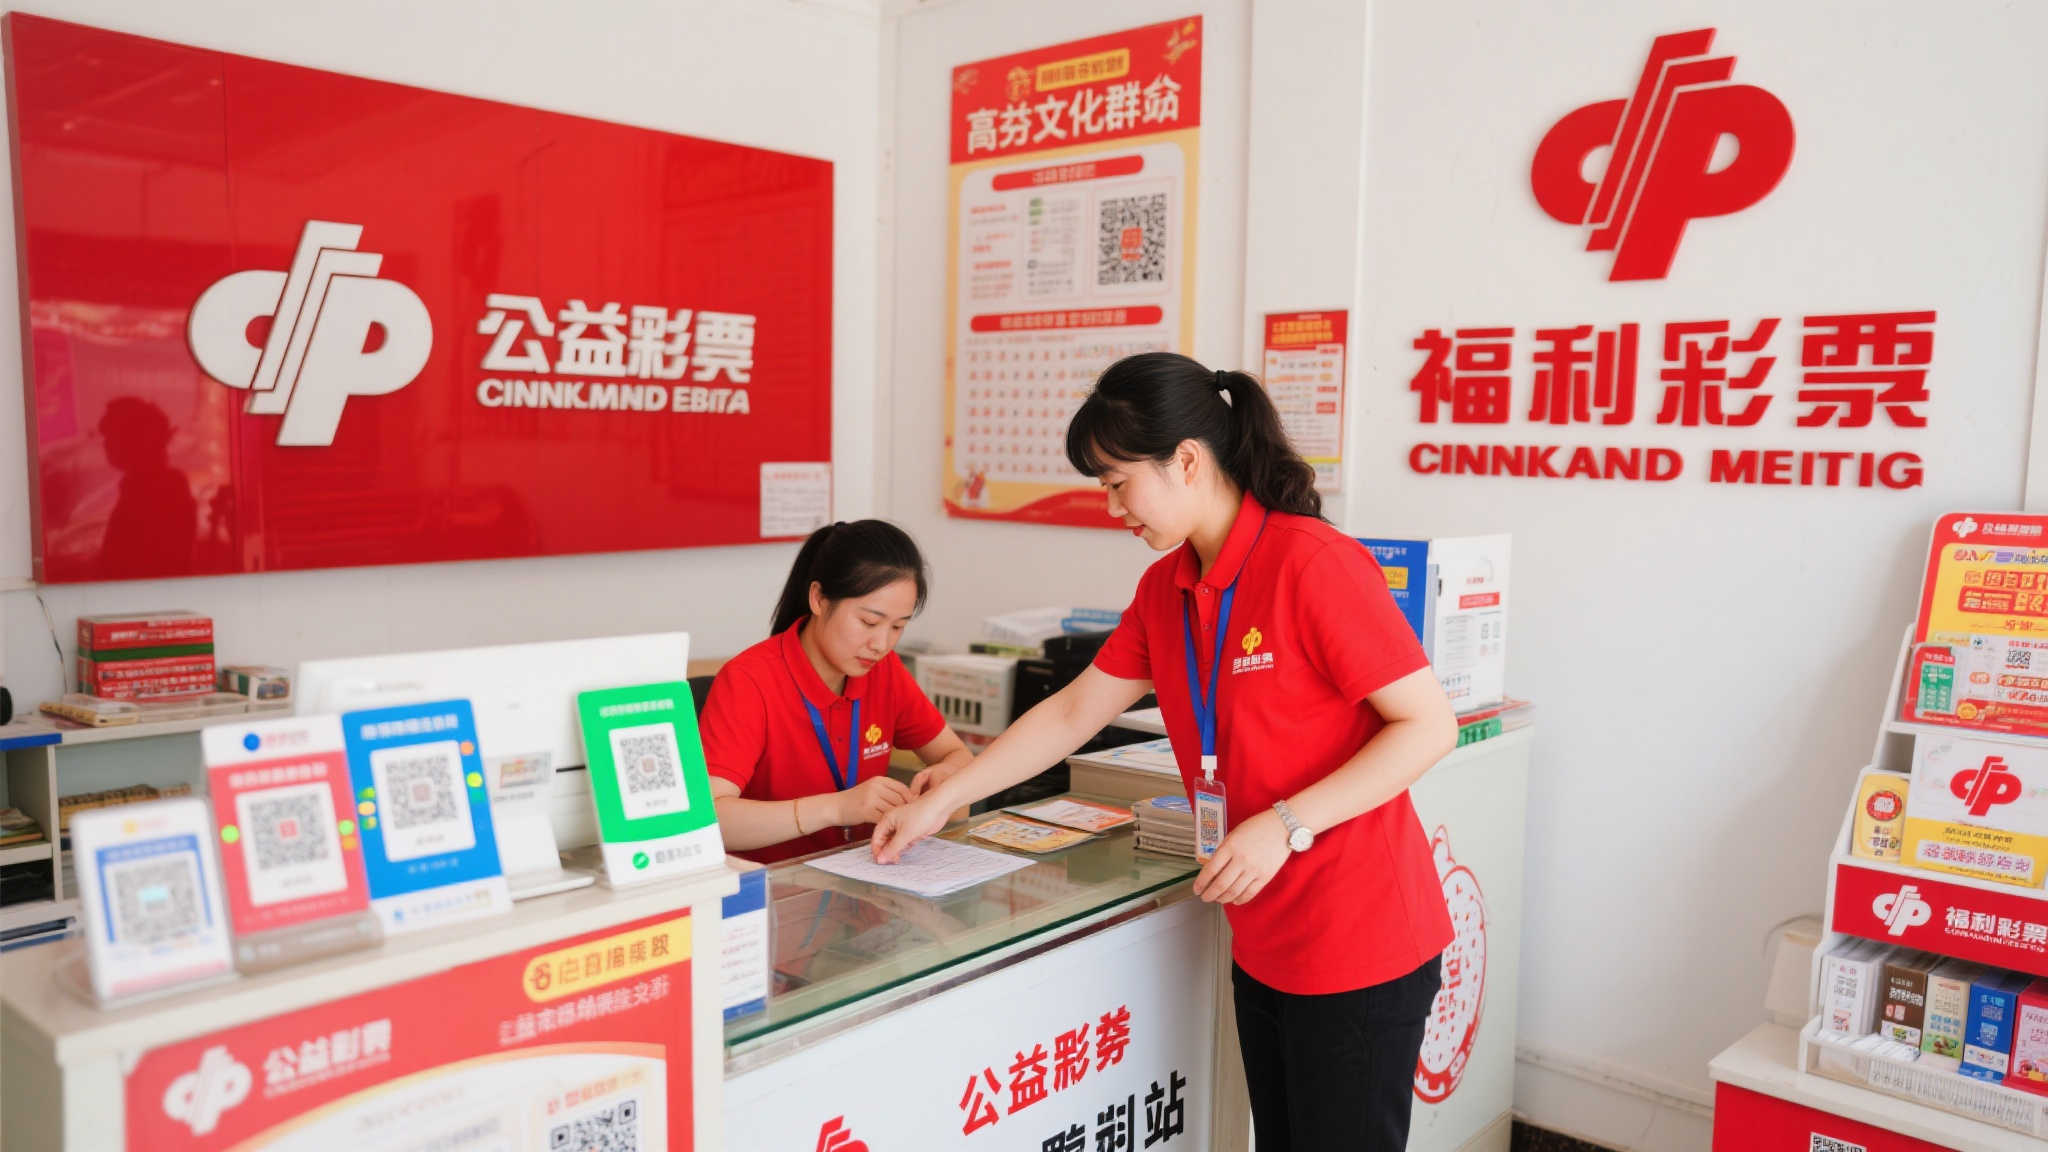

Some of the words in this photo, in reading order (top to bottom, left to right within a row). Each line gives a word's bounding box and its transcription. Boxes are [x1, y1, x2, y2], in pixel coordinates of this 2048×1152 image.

[477, 293, 757, 384] 公益彩票
[1410, 310, 1937, 428] 福利彩票
[671, 385, 751, 415] EBITA
[1408, 443, 1684, 482] CINNKAND
[1709, 449, 1924, 490] MEITIG
